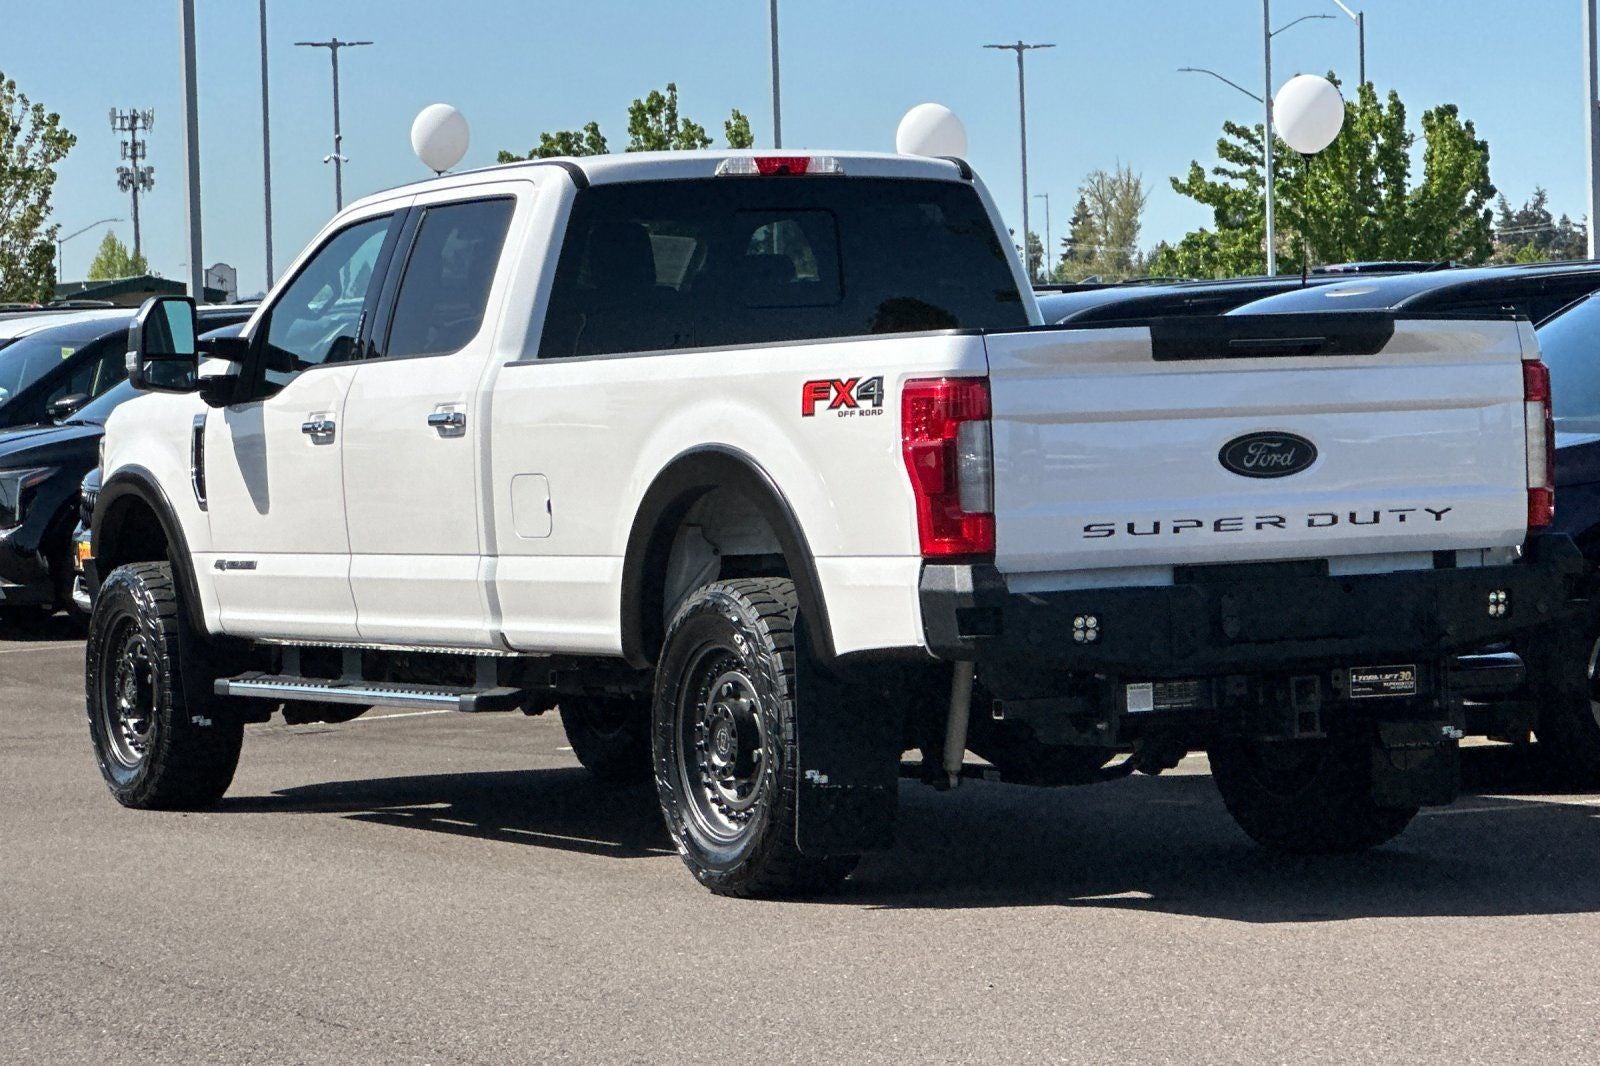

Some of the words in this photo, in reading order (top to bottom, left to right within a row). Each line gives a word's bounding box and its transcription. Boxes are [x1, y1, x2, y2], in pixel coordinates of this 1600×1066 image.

[802, 376, 884, 417] FX4
[838, 410, 855, 418] OFF
[859, 409, 884, 417] ROAD
[1243, 441, 1296, 467] Ford
[1083, 514, 1286, 538] SUPER
[1307, 506, 1452, 528] DUTY
